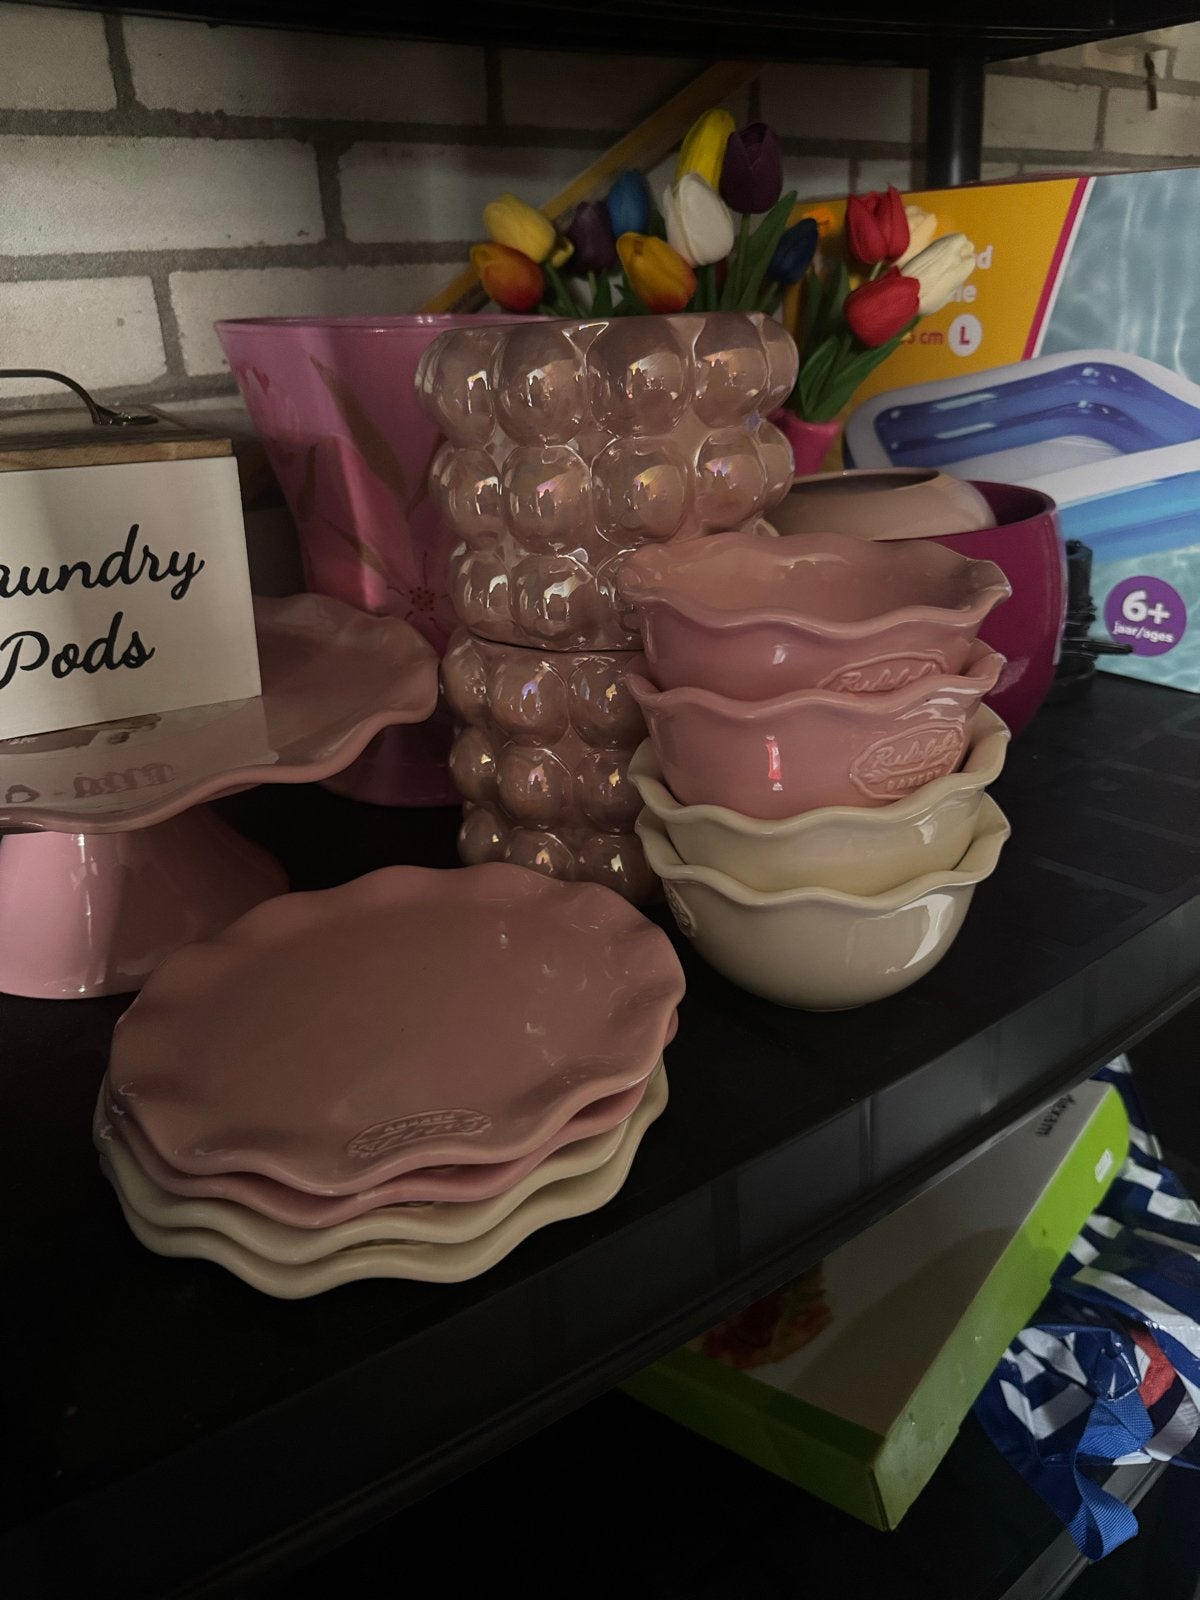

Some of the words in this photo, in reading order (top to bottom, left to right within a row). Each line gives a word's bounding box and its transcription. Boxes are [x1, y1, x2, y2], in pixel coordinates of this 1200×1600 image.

[920, 332, 944, 345] cm
[959, 326, 970, 345] L
[0, 524, 205, 600] aundry
[1122, 589, 1171, 625] 6+
[1112, 620, 1175, 643] jaar/ages
[0, 611, 156, 690] Pods
